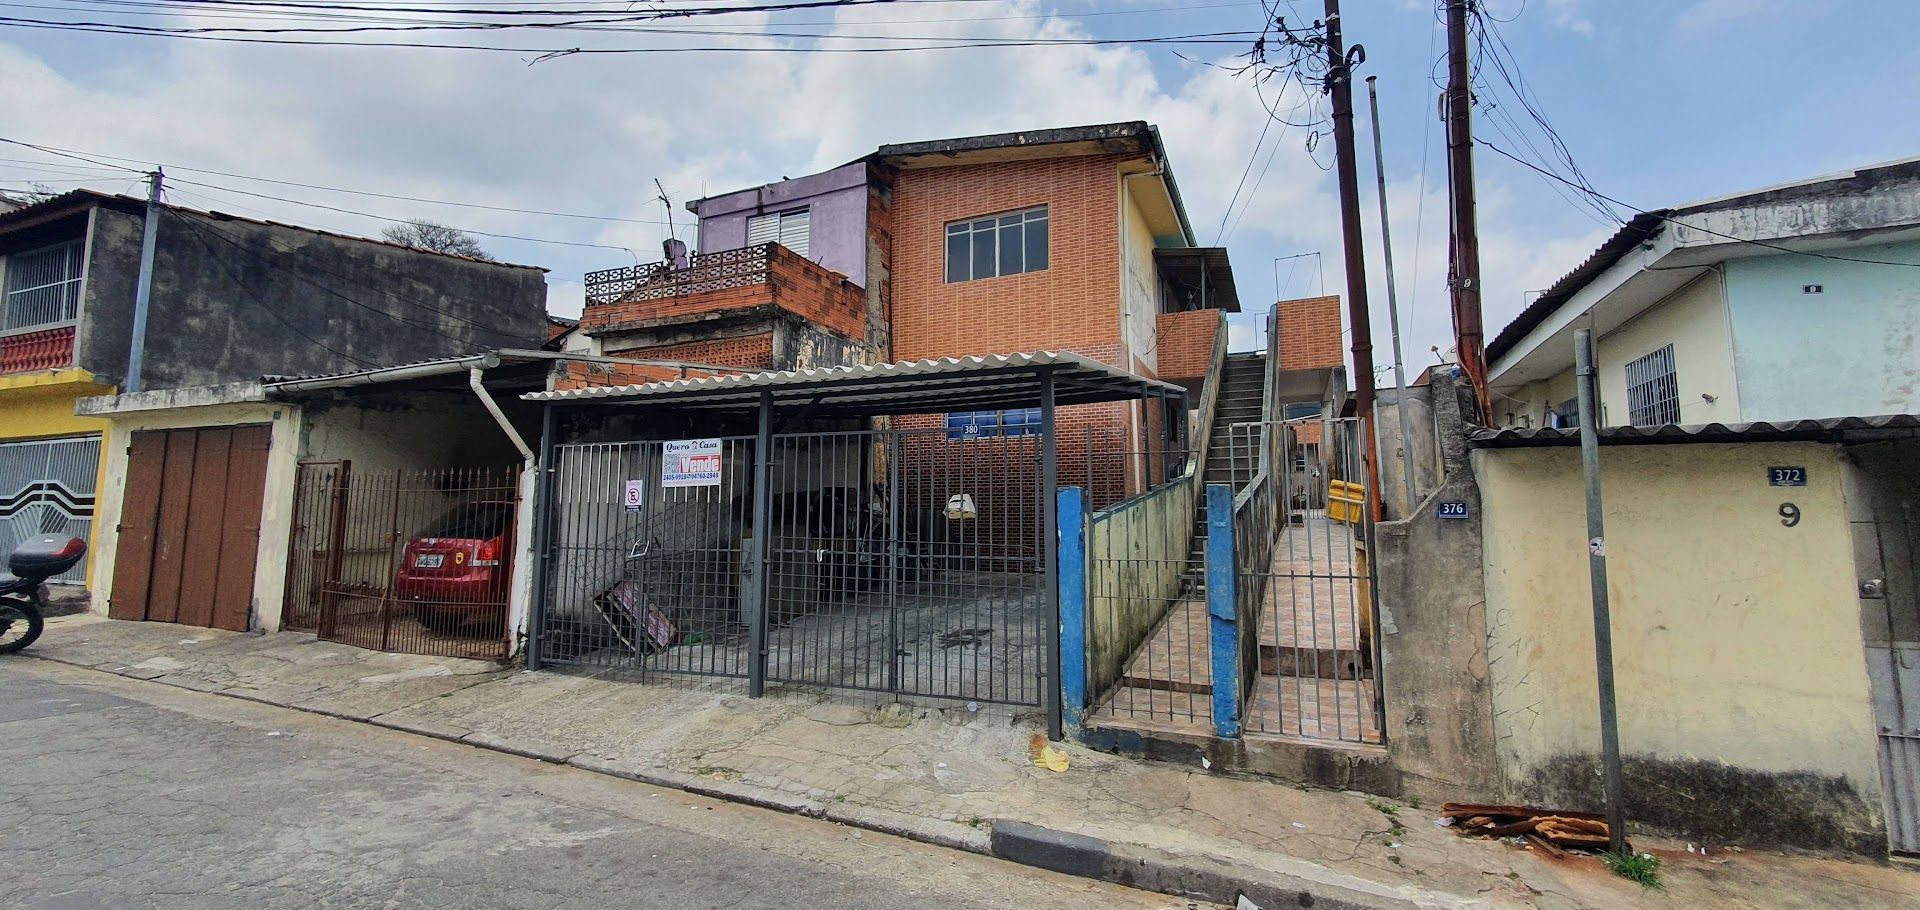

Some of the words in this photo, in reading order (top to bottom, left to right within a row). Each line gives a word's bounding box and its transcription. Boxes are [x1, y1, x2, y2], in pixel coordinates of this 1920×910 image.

[1464, 278, 1472, 288] 9
[964, 425, 978, 434] 380
[666, 442, 690, 453] Quero
[699, 440, 717, 449] Casa
[681, 455, 719, 473] Vende
[1775, 469, 1801, 481] 372
[1443, 503, 1464, 514] 376
[1778, 502, 1801, 528] 9
